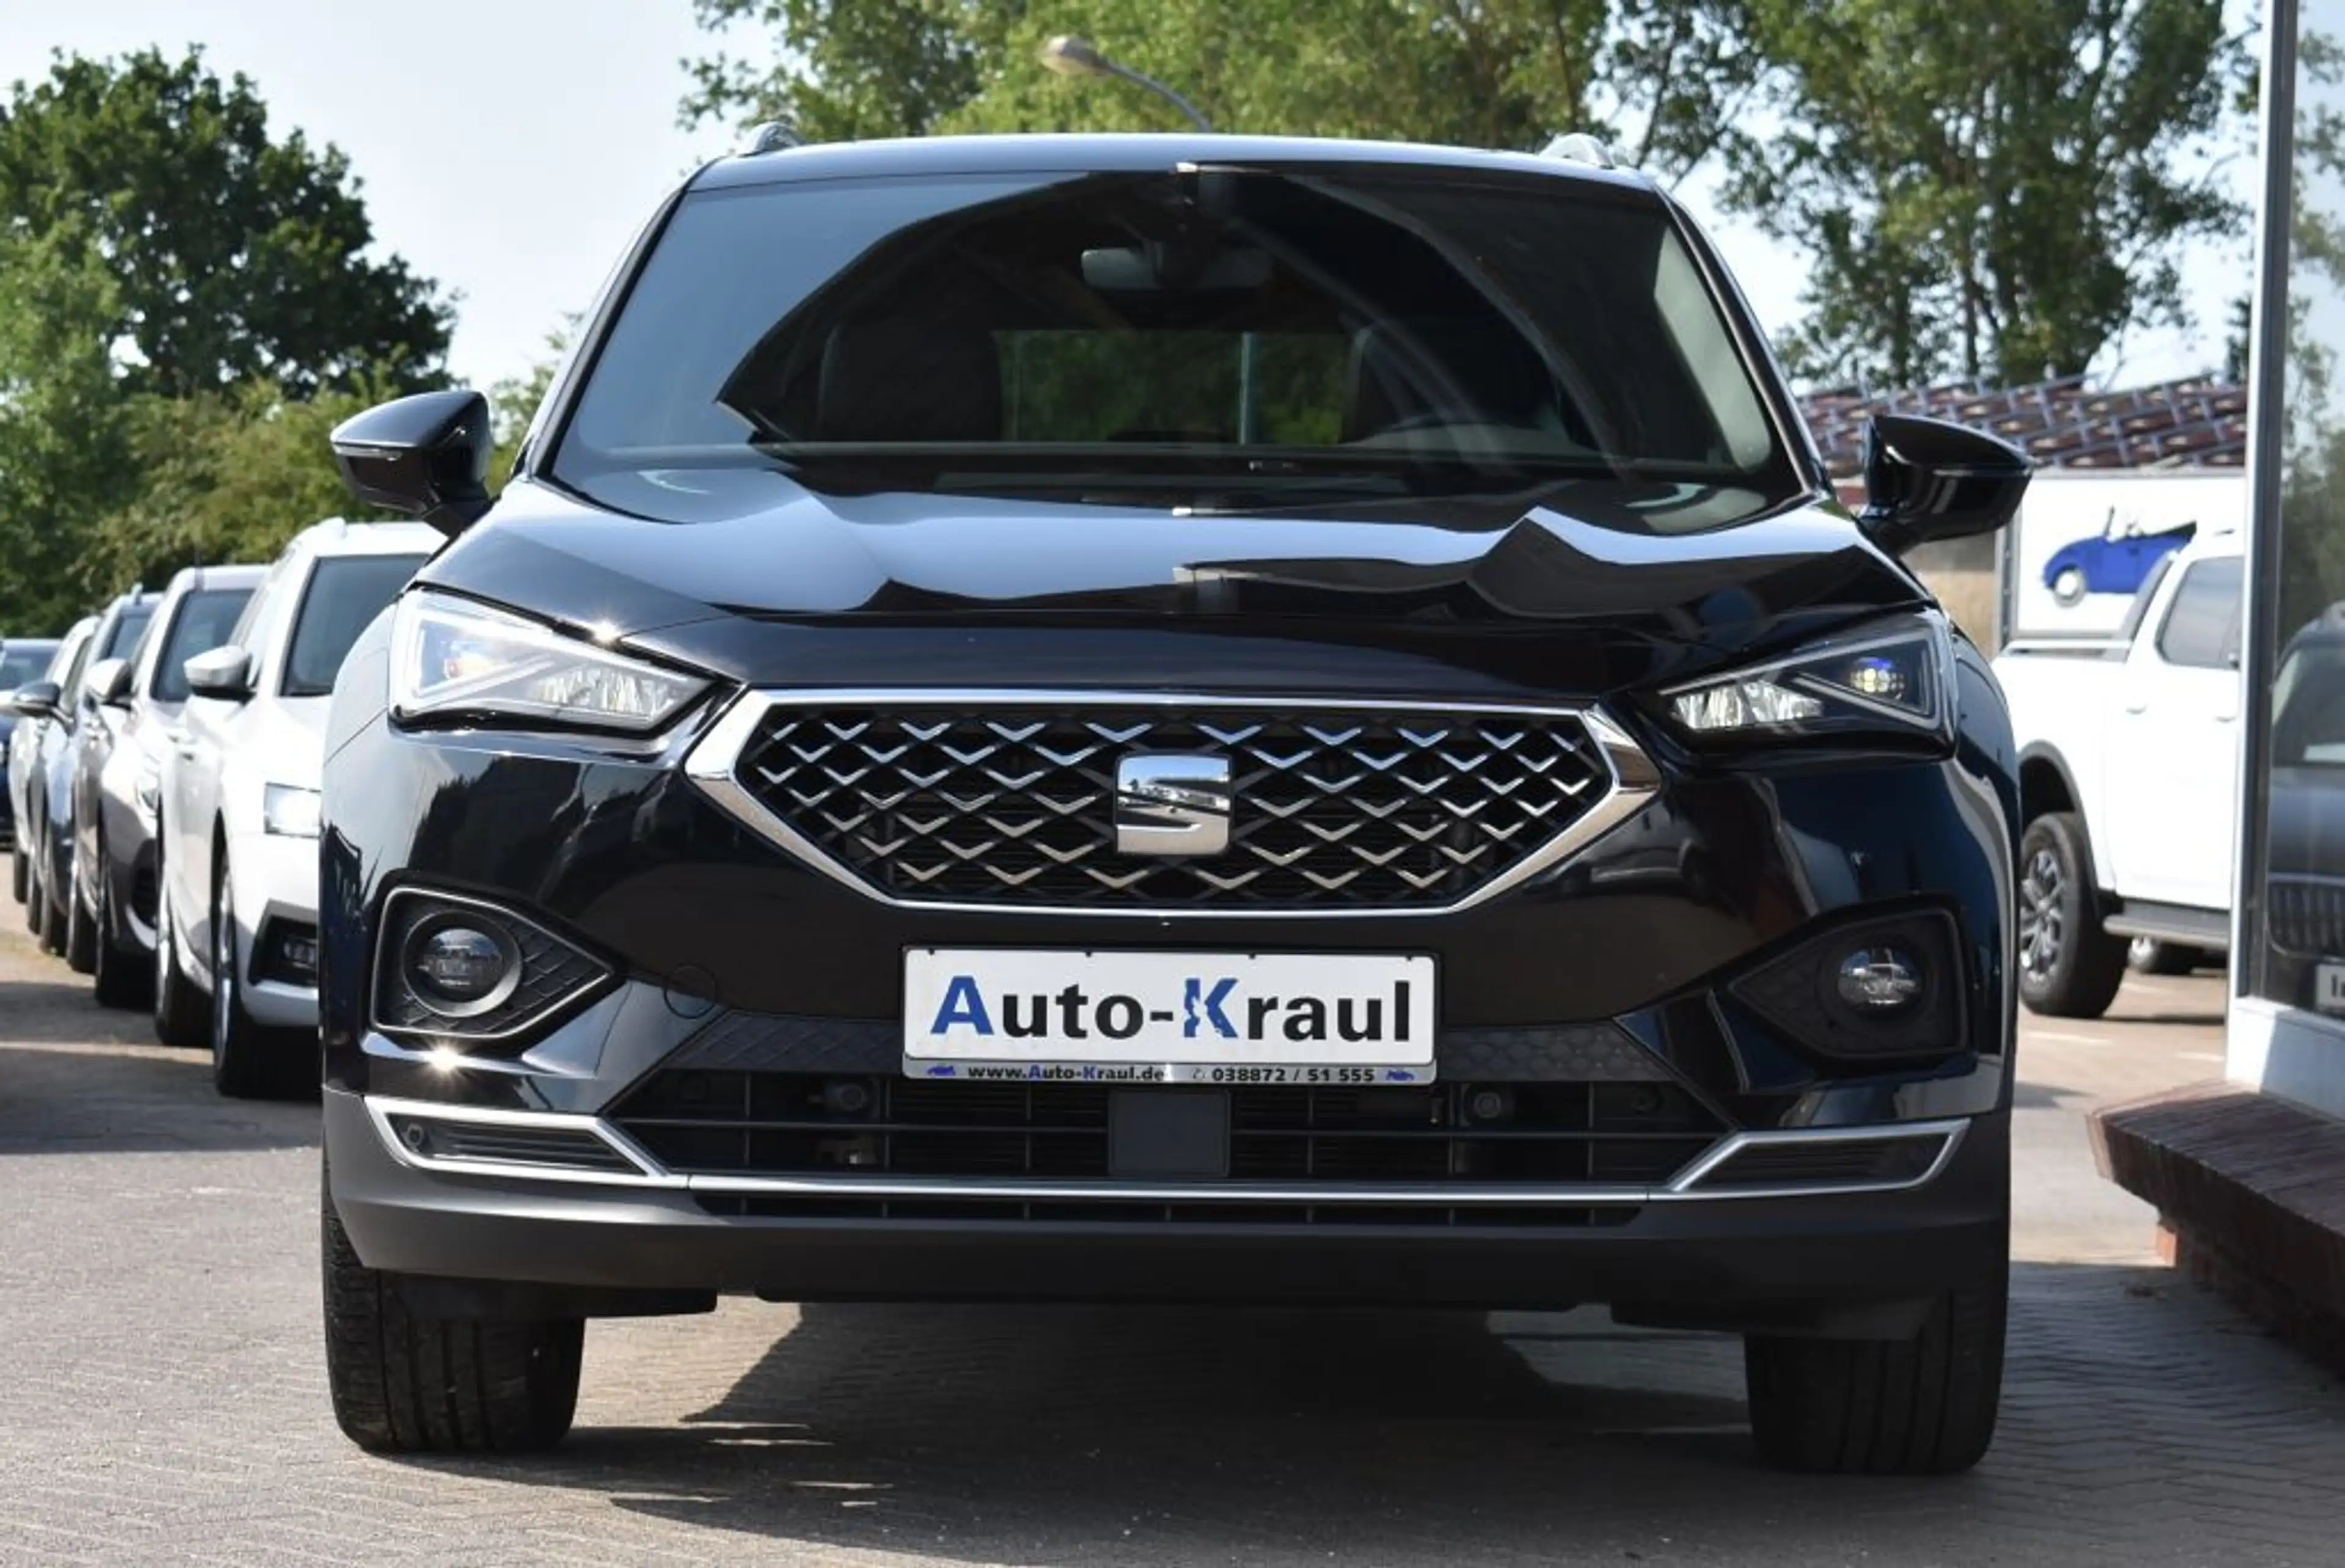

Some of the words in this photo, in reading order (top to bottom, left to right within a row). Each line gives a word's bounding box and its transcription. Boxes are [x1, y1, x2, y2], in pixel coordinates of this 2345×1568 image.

[930, 975, 1410, 1042] Auto-Kraul
[968, 1064, 1165, 1081] www.Auto-Kraul.de
[1212, 1067, 1285, 1081] 038872
[1307, 1068, 1330, 1081] 51
[1339, 1069, 1375, 1081] 555
